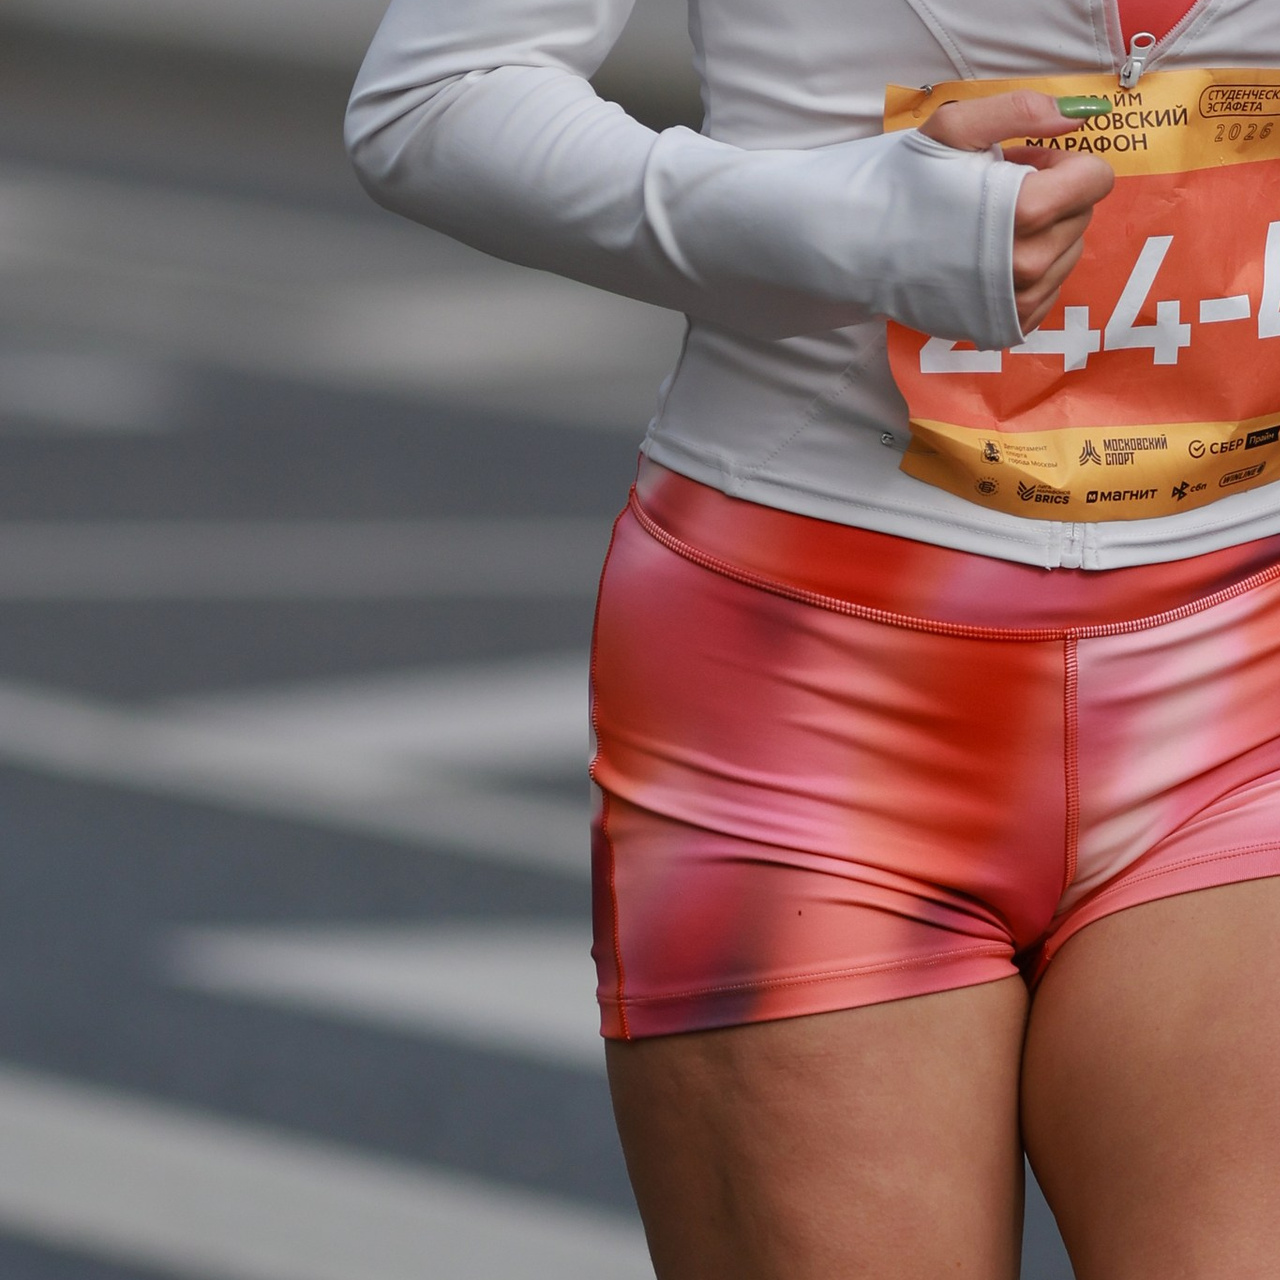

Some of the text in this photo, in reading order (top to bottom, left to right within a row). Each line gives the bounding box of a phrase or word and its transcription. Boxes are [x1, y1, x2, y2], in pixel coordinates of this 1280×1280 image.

[1206, 100, 1264, 113] ЭСТАФЕТА
[1077, 104, 1189, 132] КОВСКИЙ
[1213, 122, 1275, 143] 2026
[1025, 133, 1149, 154] МАРАФОН
[1102, 434, 1169, 452] МОСКОВСКИЙ
[1209, 432, 1276, 455] СБЕР Прайм
[1105, 451, 1135, 466] СПОРТ
[1034, 494, 1070, 505] BRICS
